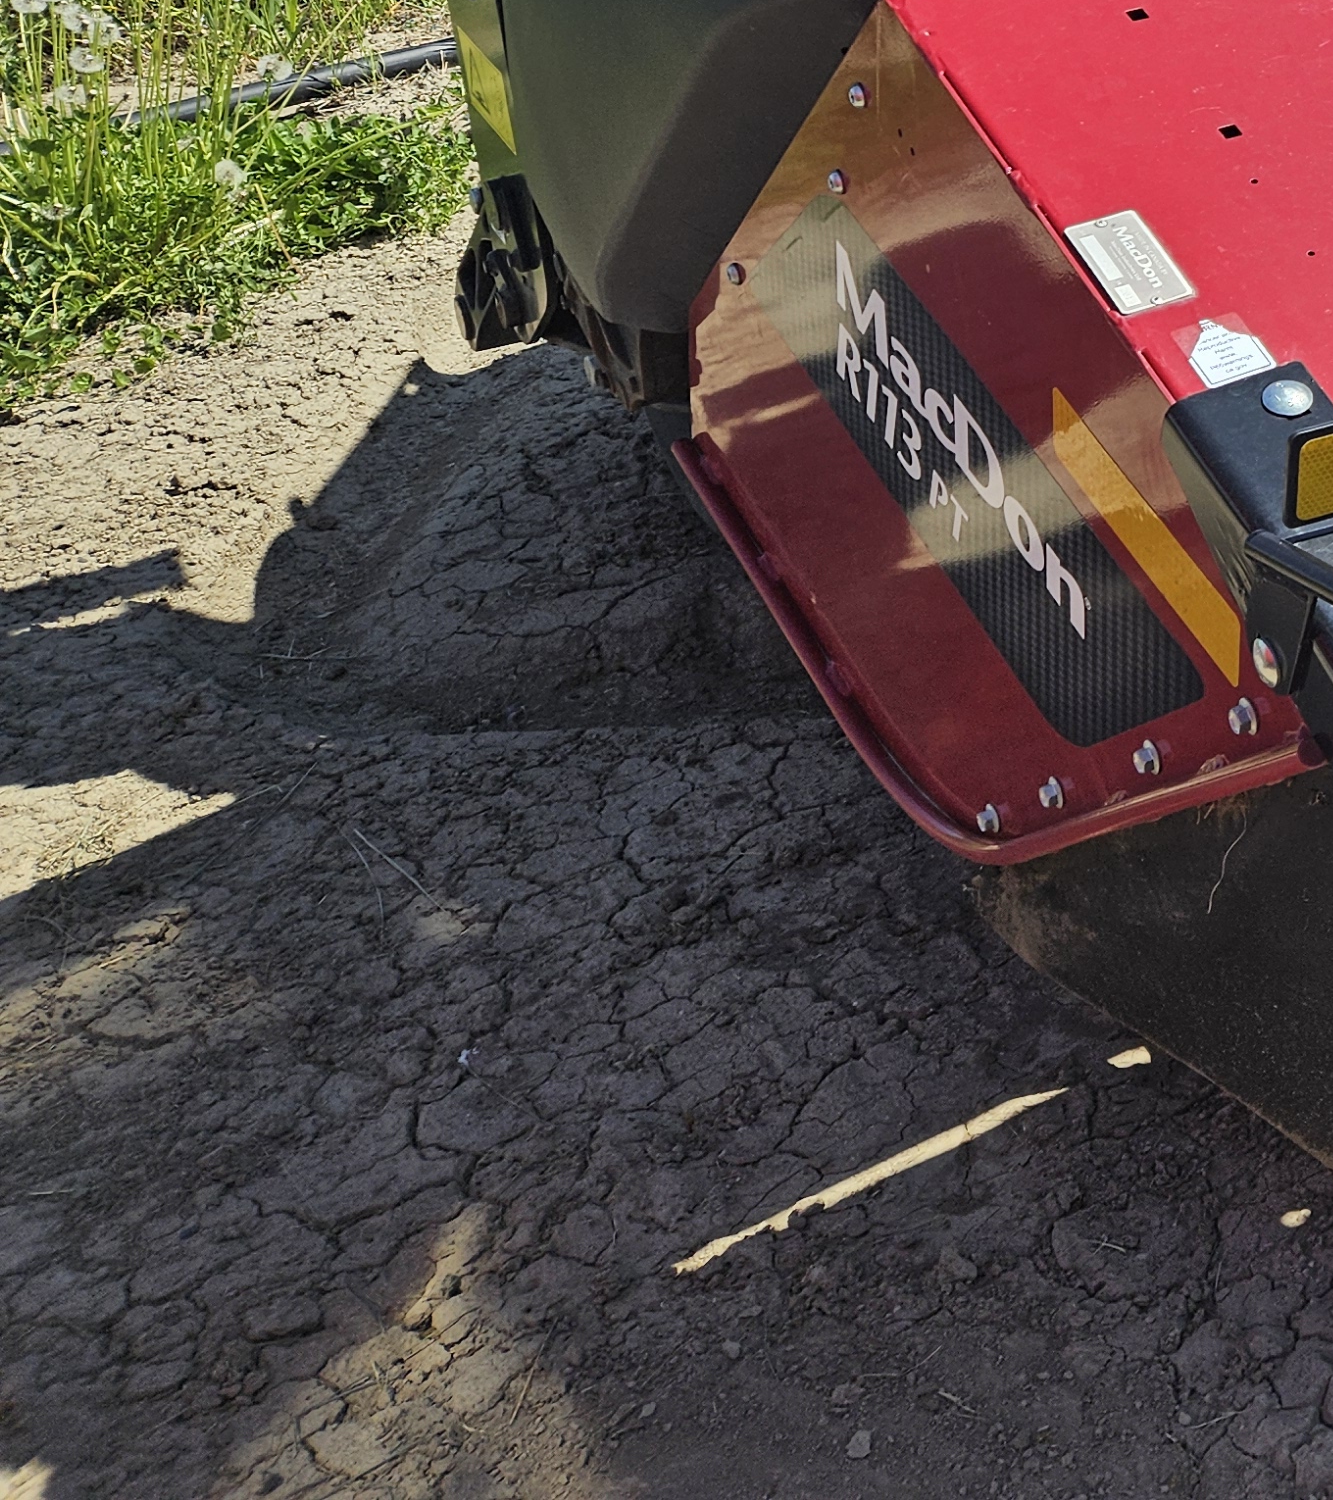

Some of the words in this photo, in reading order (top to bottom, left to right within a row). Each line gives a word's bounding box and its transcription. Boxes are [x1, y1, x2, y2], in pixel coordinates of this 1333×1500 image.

[1112, 225, 1163, 289] MacDon
[836, 323, 922, 480] R113
[929, 469, 969, 542] PT
[836, 239, 1086, 640] MacDon
